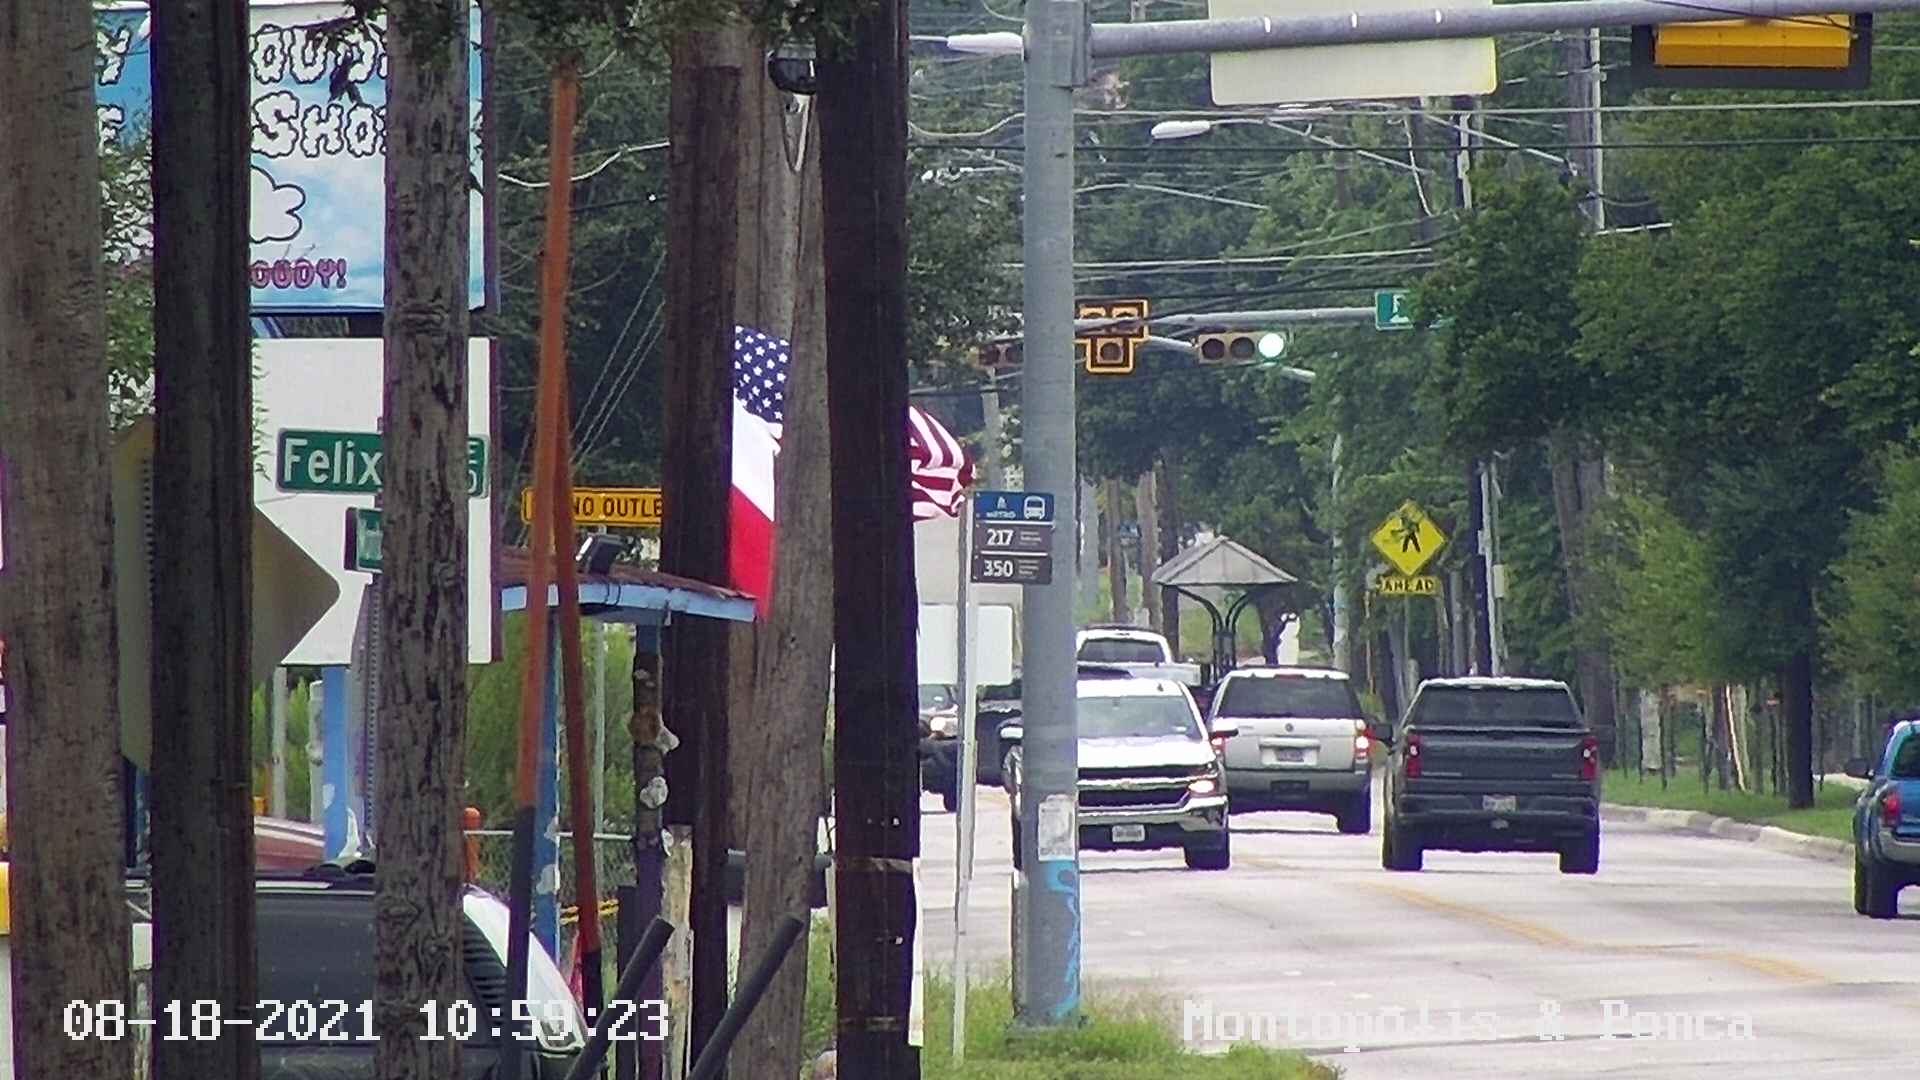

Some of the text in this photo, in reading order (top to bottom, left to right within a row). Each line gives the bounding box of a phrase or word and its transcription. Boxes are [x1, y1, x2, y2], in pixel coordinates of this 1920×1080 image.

[250, 91, 387, 158] SHO
[284, 438, 383, 485] Felix
[603, 498, 663, 517] OUTLE
[986, 529, 1014, 546] 217
[983, 560, 1014, 577] 350
[1383, 579, 1434, 592] AHEAD
